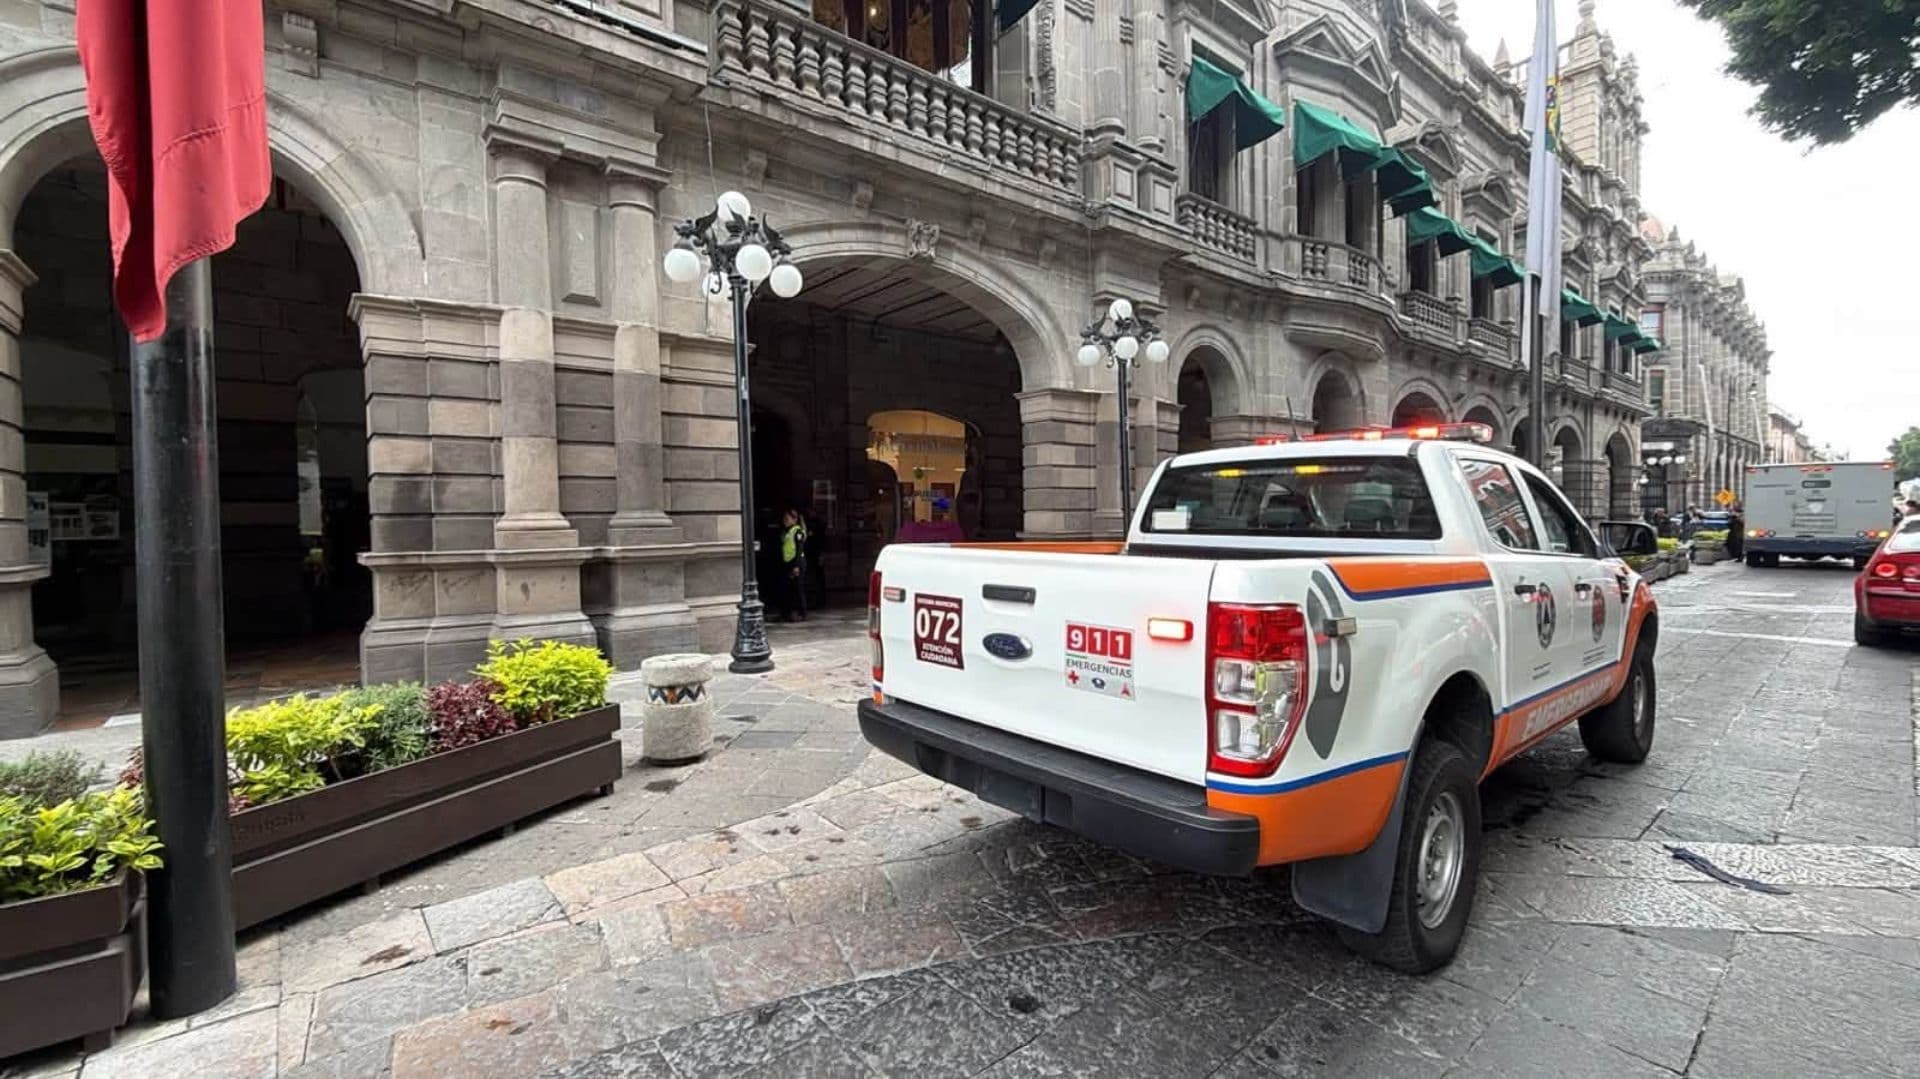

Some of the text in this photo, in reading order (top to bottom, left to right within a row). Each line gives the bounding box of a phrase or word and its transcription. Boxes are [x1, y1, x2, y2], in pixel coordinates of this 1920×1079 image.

[916, 608, 960, 644] 072
[1069, 627, 1125, 656] 911
[920, 650, 959, 666] CIUDADANA
[1066, 657, 1133, 679] EMERGENCIAS
